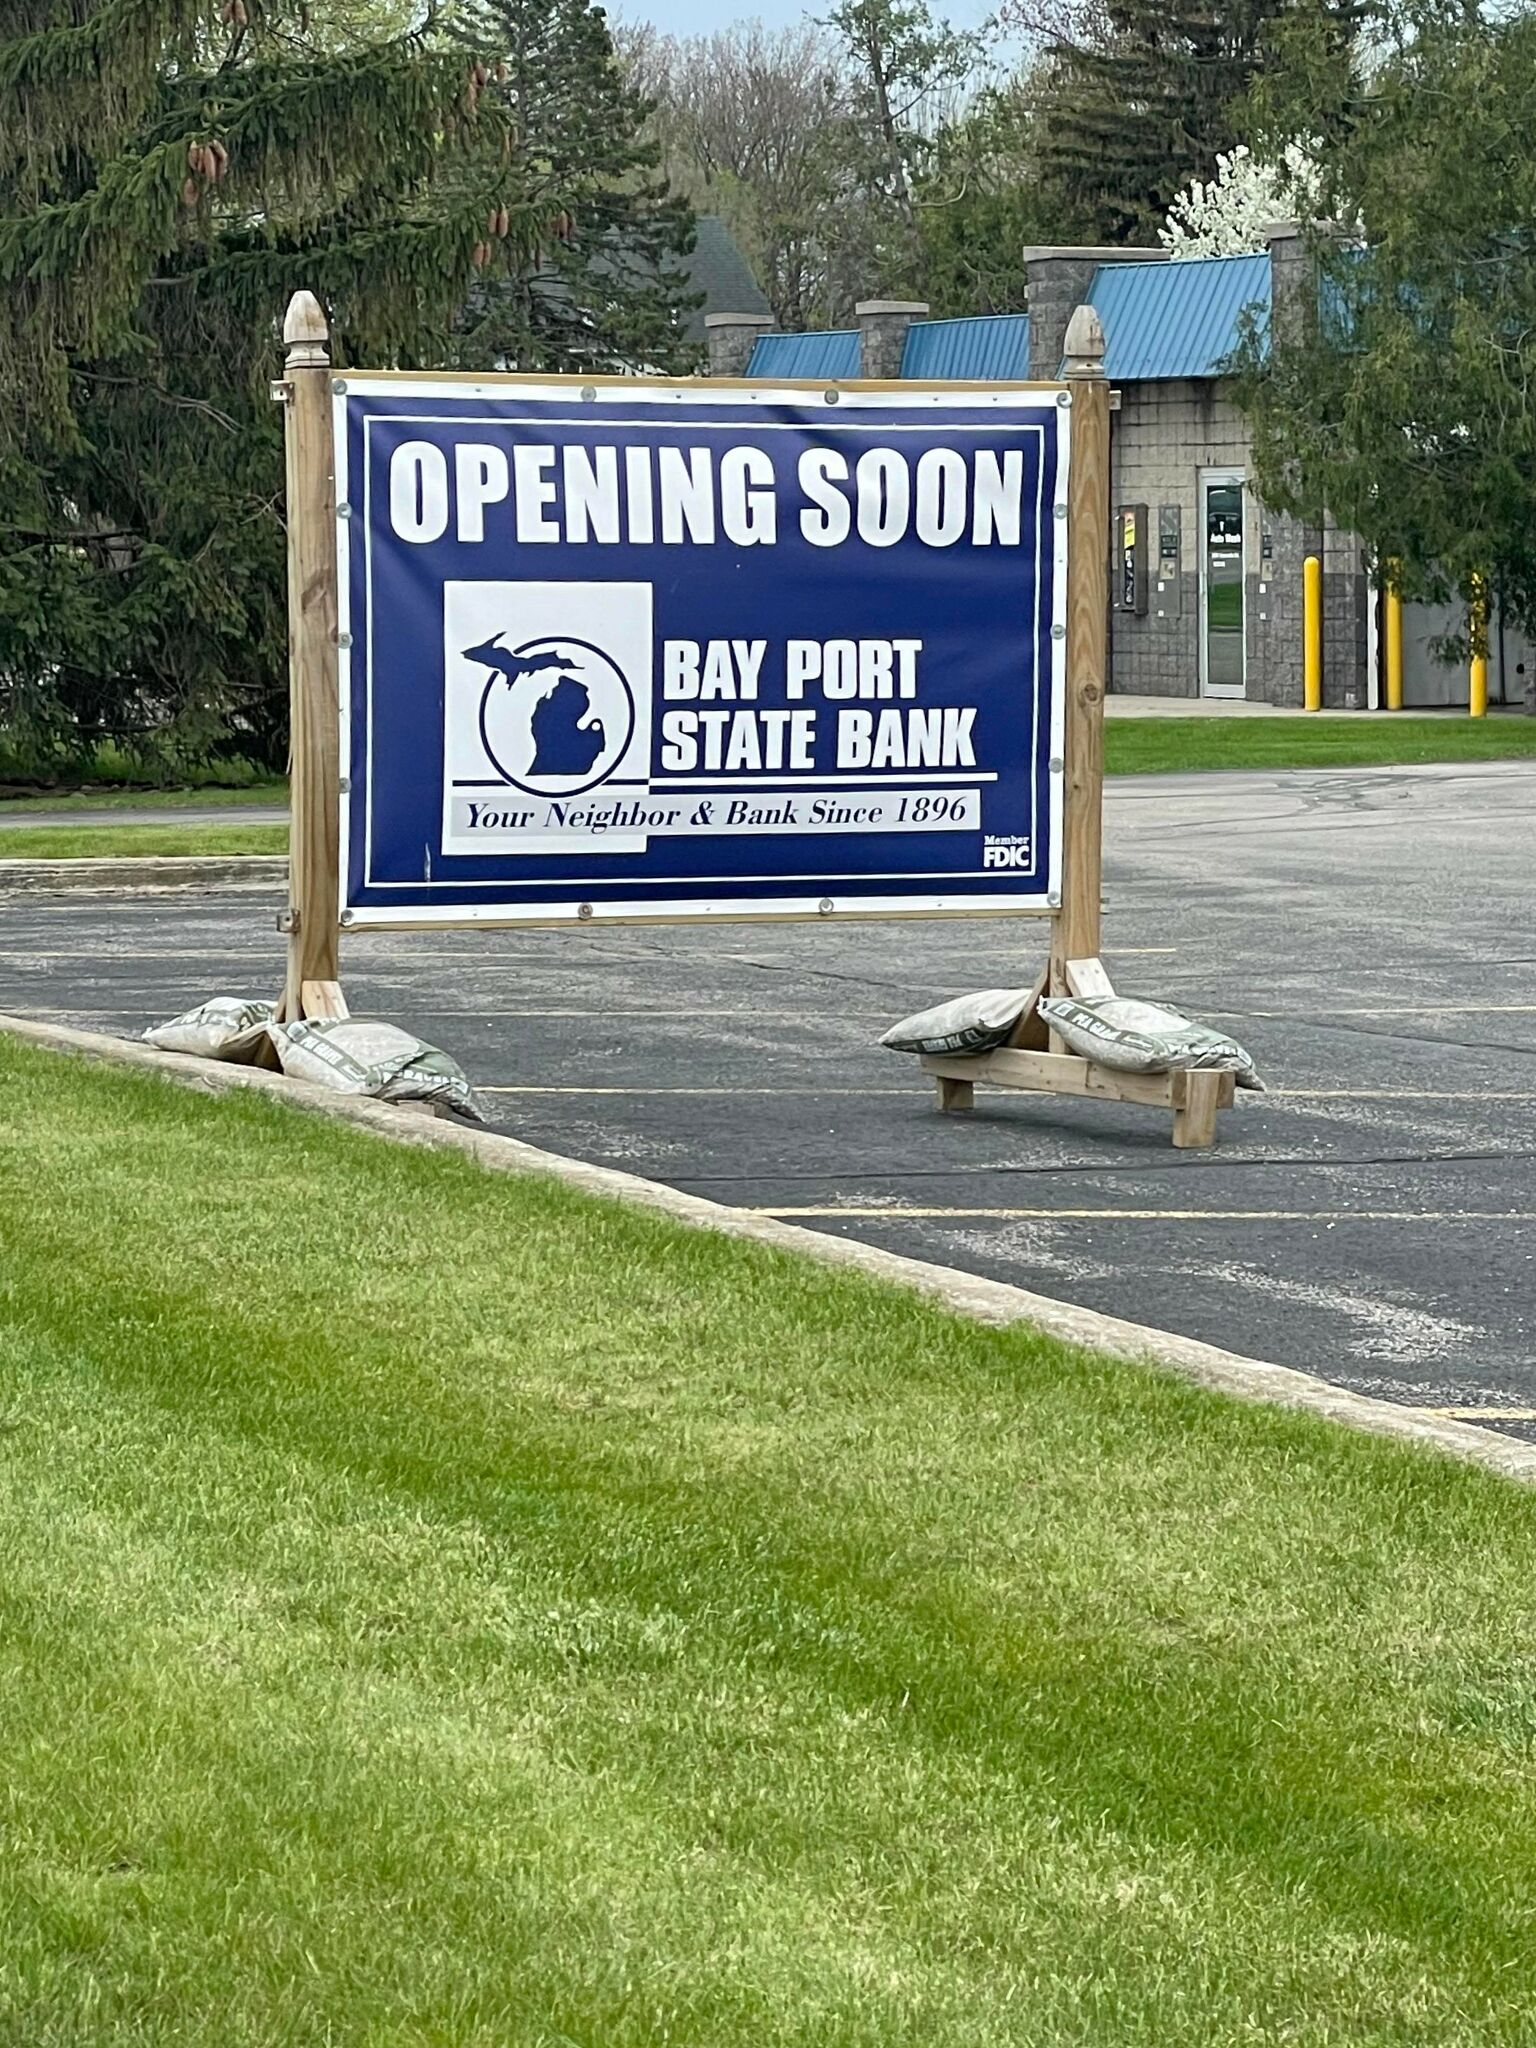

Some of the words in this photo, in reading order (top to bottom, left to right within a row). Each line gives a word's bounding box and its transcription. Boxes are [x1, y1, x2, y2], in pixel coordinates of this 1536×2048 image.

[389, 440, 777, 547] OPENING
[797, 447, 1024, 547] SOON
[663, 640, 767, 701] BAY
[786, 639, 923, 700] PORT
[661, 709, 817, 771] STATE
[836, 708, 977, 769] BANK
[466, 803, 535, 829] Your
[543, 801, 681, 835] Neighbor
[690, 800, 715, 826] &
[725, 800, 799, 826] Bank
[808, 798, 882, 825] Since
[896, 796, 967, 823] 1896
[984, 835, 1030, 845] Member
[983, 845, 1030, 868] FDIC
